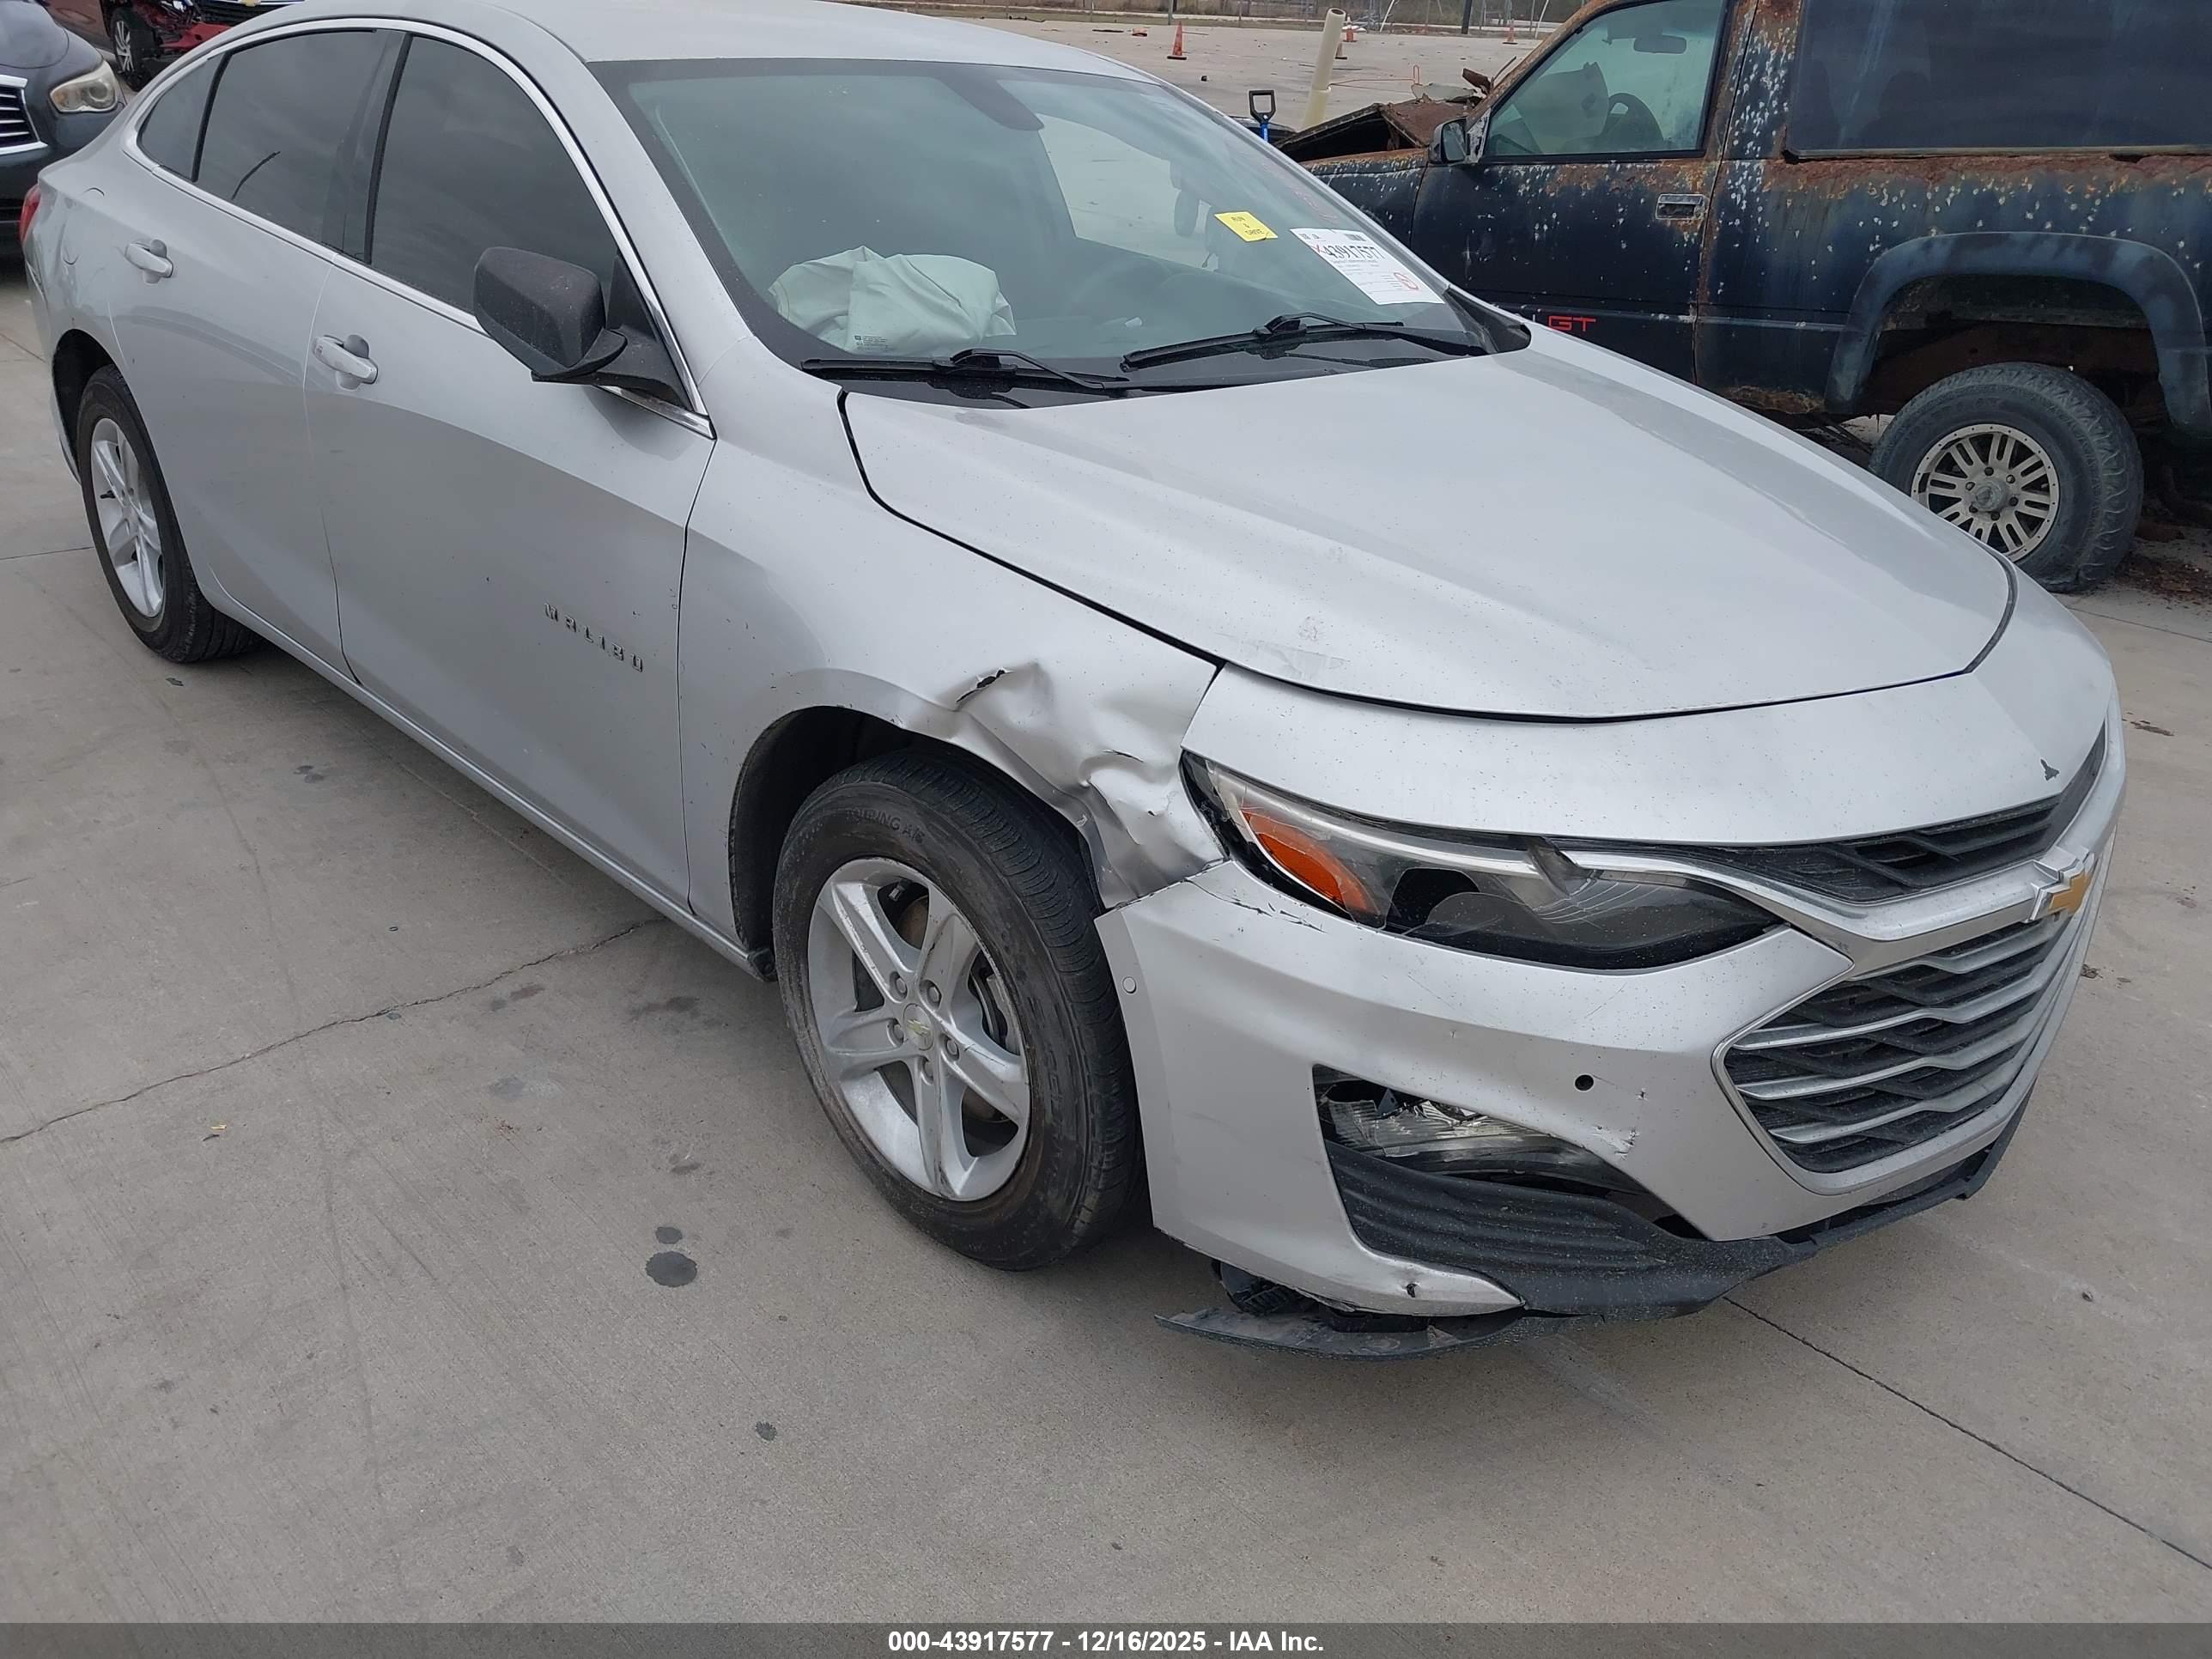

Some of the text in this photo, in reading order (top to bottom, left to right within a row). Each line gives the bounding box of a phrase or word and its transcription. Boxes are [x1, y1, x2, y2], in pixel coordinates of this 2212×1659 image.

[1322, 244, 1385, 260] 43917577
[1548, 315, 1596, 331] GT
[544, 602, 643, 672] MALIBU
